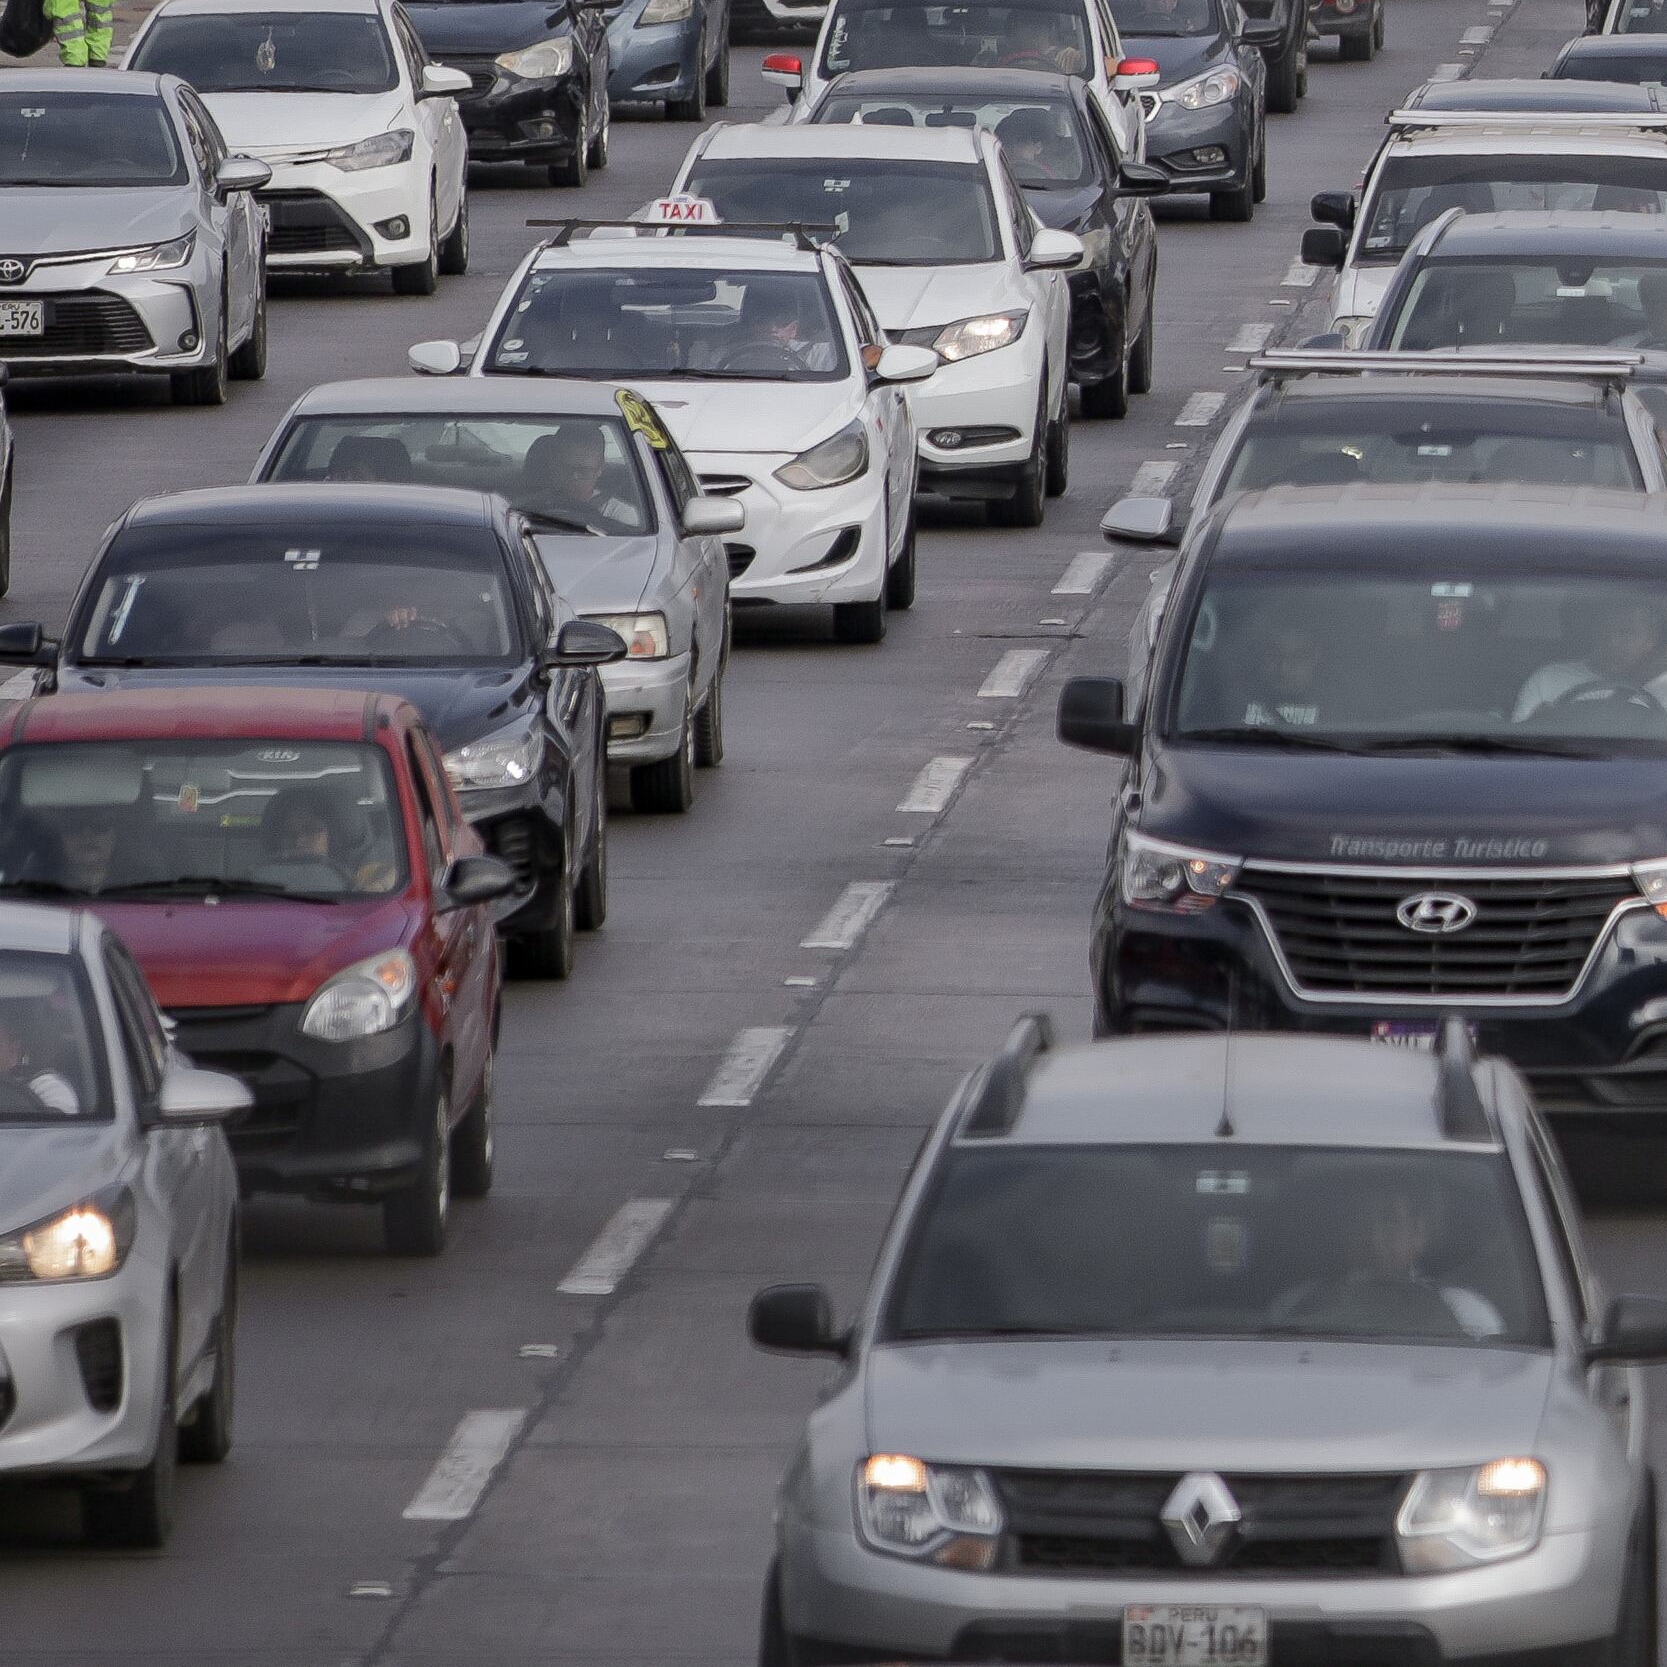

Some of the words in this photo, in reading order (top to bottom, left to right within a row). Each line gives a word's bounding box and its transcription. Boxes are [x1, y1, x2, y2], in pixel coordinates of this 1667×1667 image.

[659, 202, 704, 220] TAXI
[0, 303, 20, 311] ERU
[1331, 835, 1446, 859] Transporte
[1167, 1606, 1218, 1622] PERU
